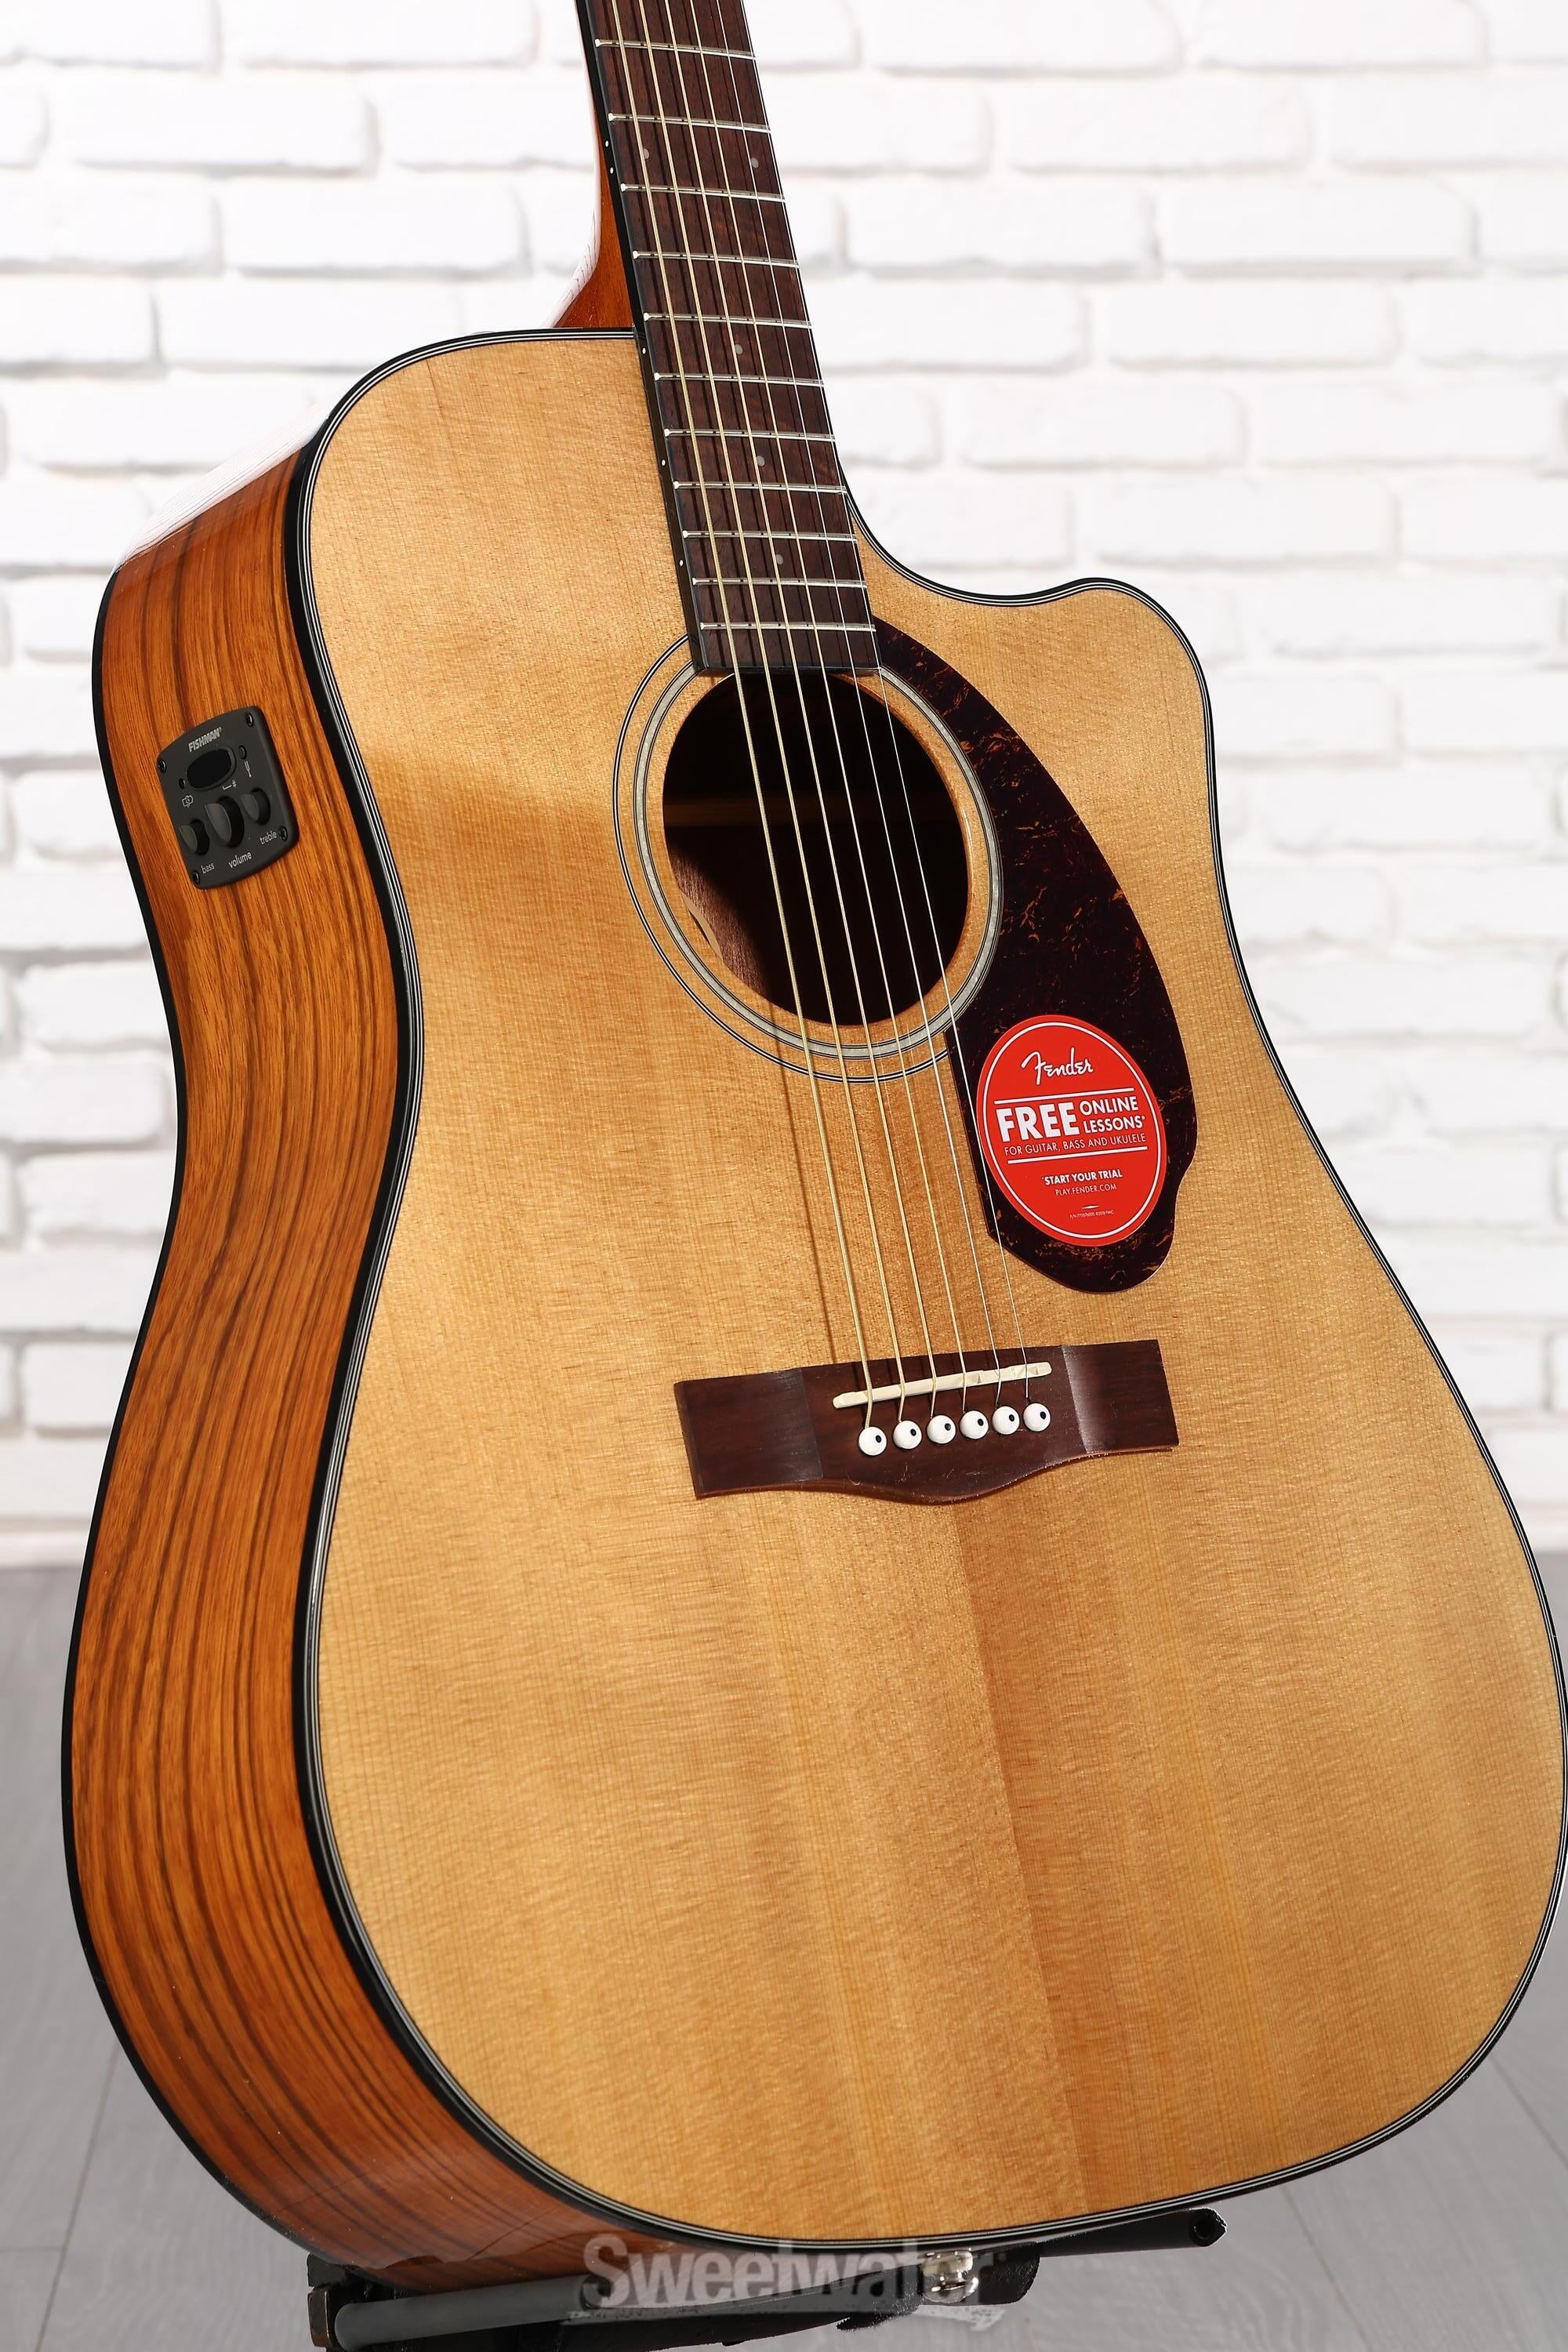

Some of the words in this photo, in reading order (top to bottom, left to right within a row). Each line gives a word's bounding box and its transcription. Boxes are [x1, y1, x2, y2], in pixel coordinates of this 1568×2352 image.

[260, 831, 277, 844] treble
[201, 862, 215, 874] bass
[228, 852, 252, 869] volume
[1021, 1047, 1094, 1085] Fender
[996, 1102, 1080, 1142] FREE
[1080, 1096, 1138, 1116] ONLINE
[1004, 1145, 1022, 1156] FOR
[1025, 1142, 1061, 1154] GUITAR,
[1063, 1140, 1085, 1150] BASS
[1088, 1138, 1108, 1147] AND
[1110, 1133, 1145, 1145] UKULELE
[1071, 1171, 1097, 1182] YOUR
[1098, 1169, 1123, 1179] TRIAL
[1055, 1184, 1117, 1196] PLAY.FENDER.COM
